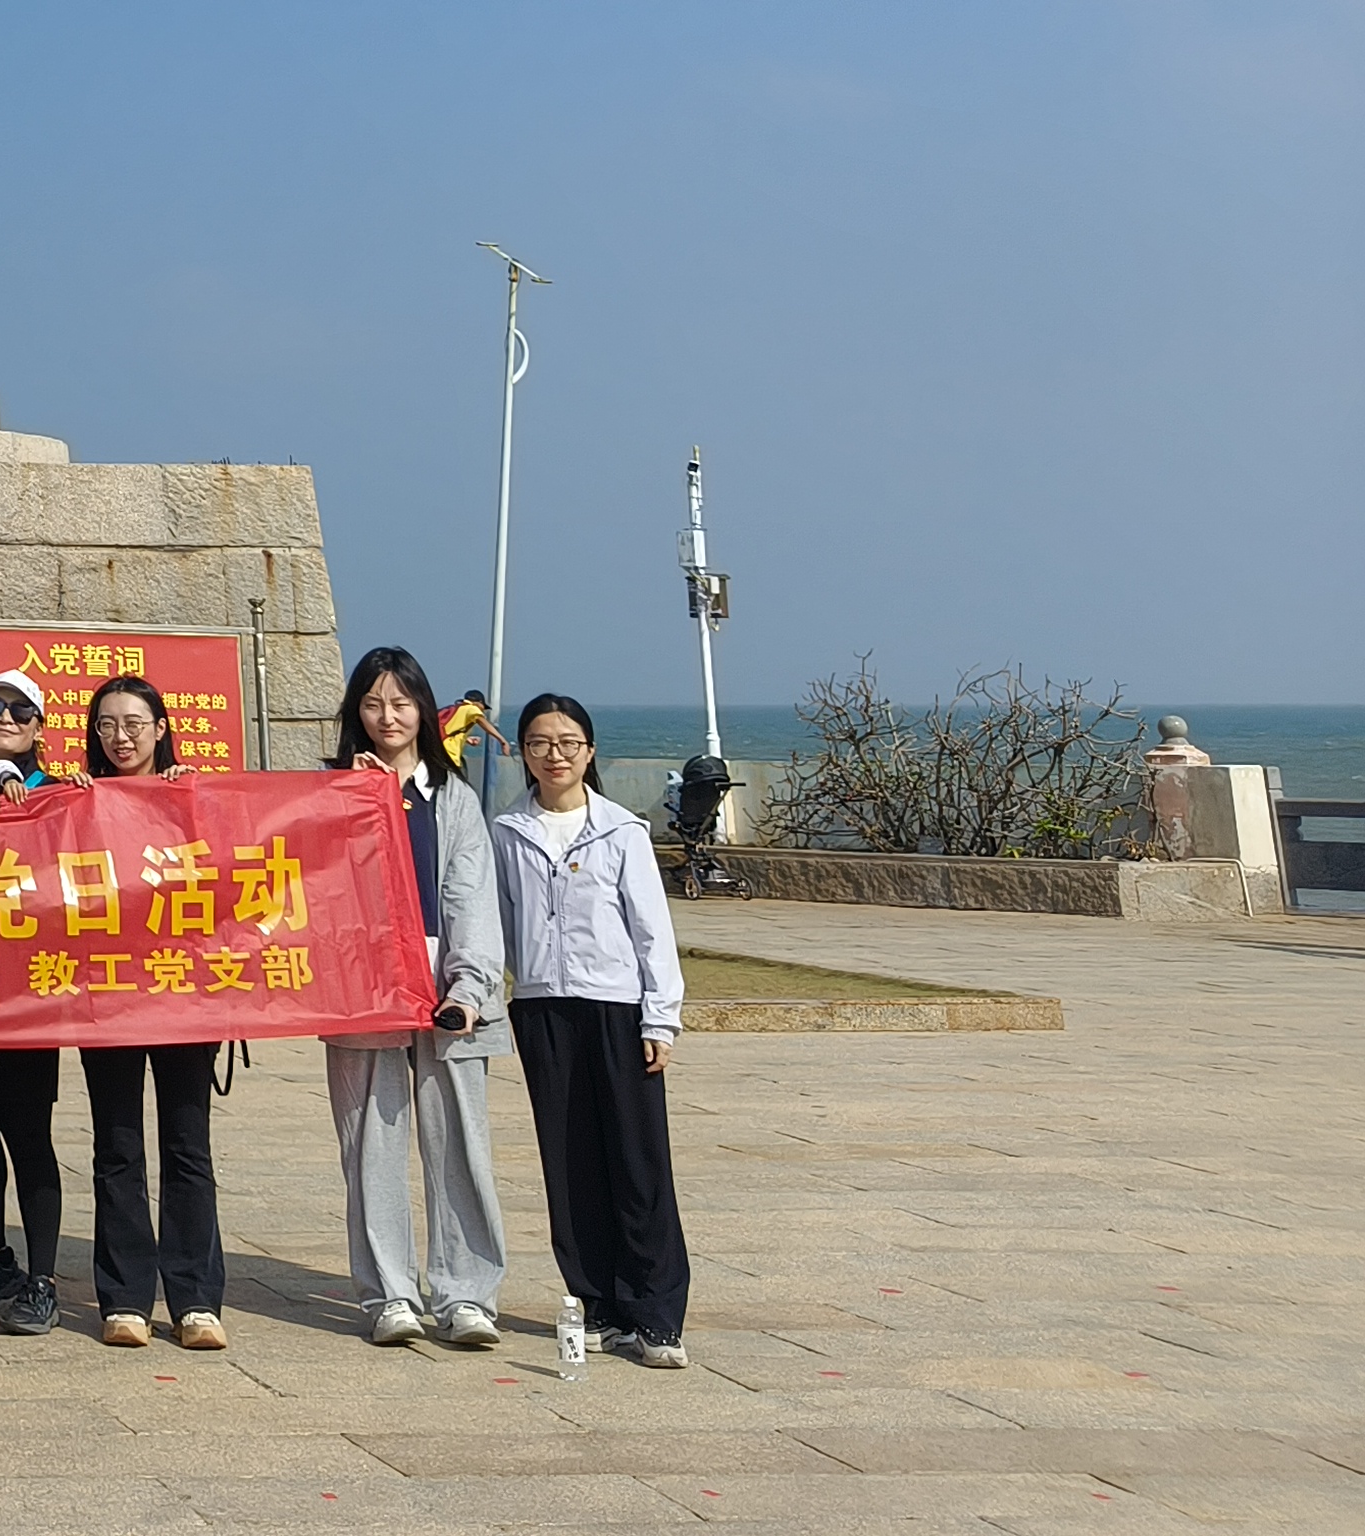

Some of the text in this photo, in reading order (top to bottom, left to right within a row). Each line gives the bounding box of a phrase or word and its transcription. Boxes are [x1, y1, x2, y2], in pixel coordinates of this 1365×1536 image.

[18, 642, 146, 678] 入党誓词
[162, 691, 228, 710] 拥护党的
[180, 740, 230, 758] 保守党
[28, 944, 314, 998] 教工党支部
